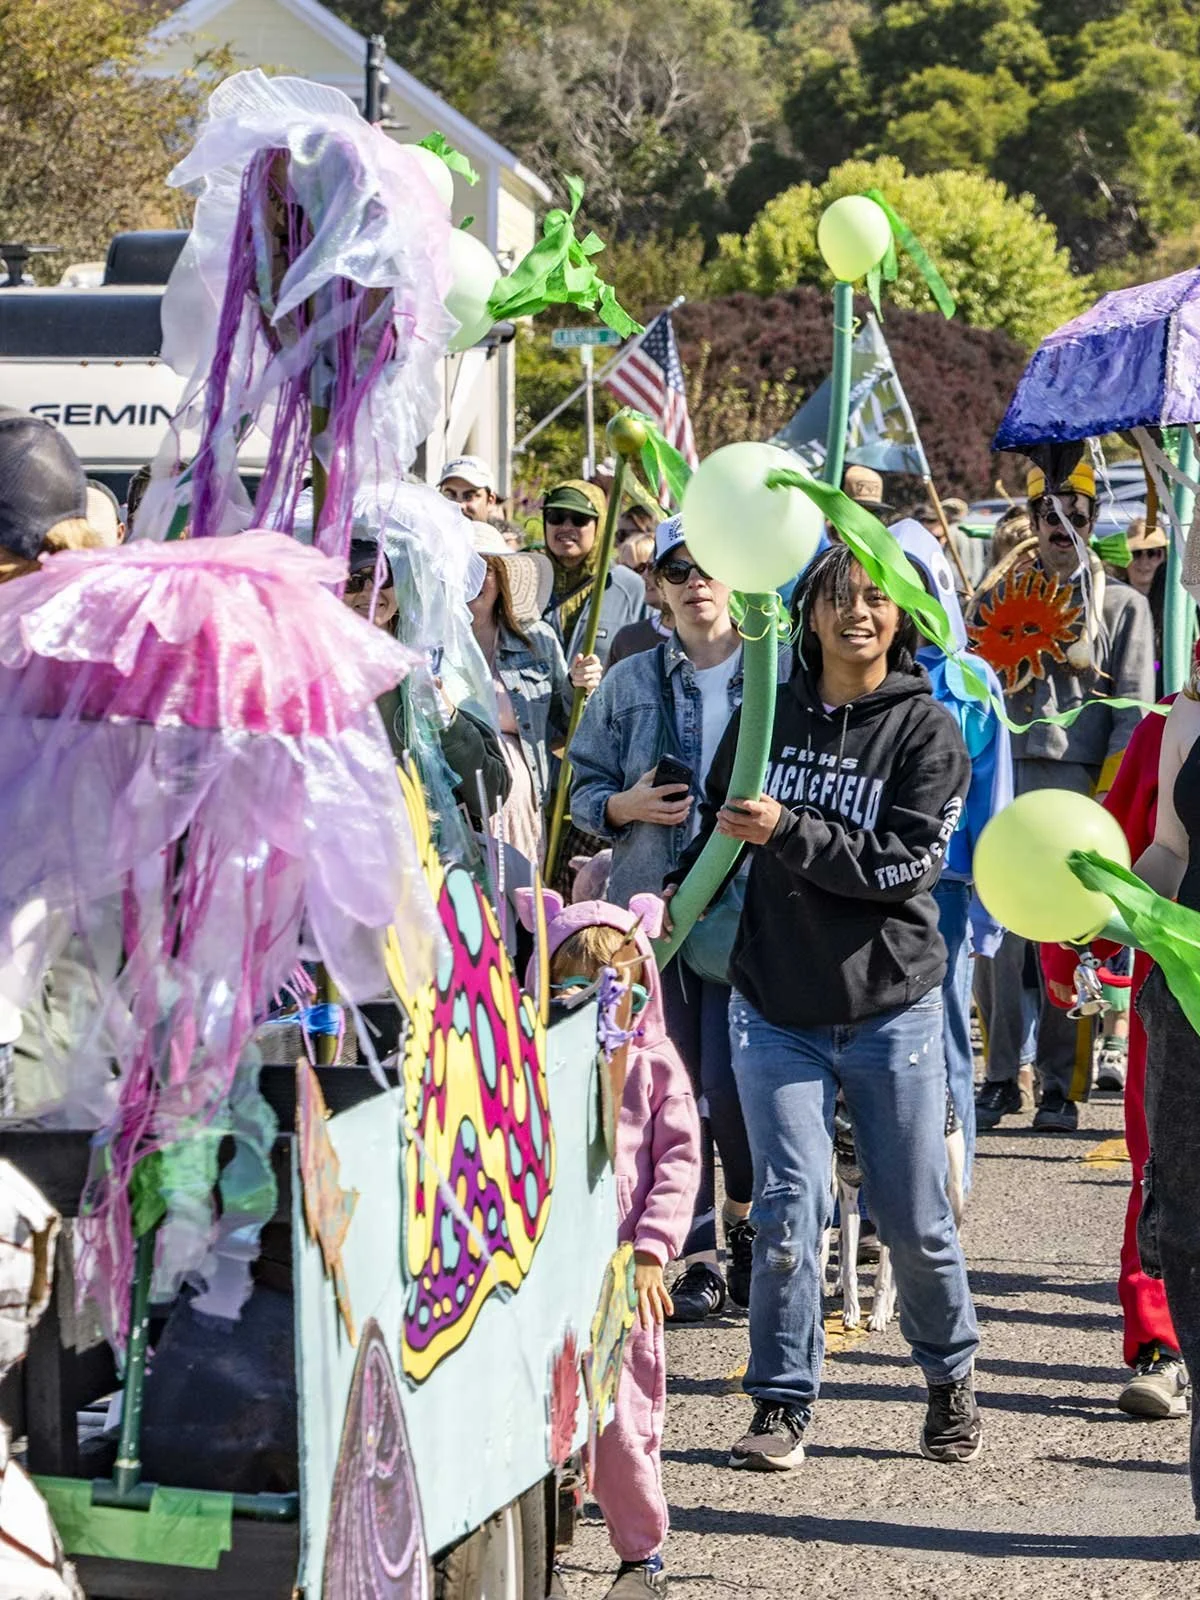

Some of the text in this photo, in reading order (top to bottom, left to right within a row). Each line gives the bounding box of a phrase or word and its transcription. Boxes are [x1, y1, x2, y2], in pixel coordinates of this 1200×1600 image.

[781, 745, 859, 770] FBHS
[819, 772, 884, 831] FIELD
[875, 854, 933, 890] TRACK
